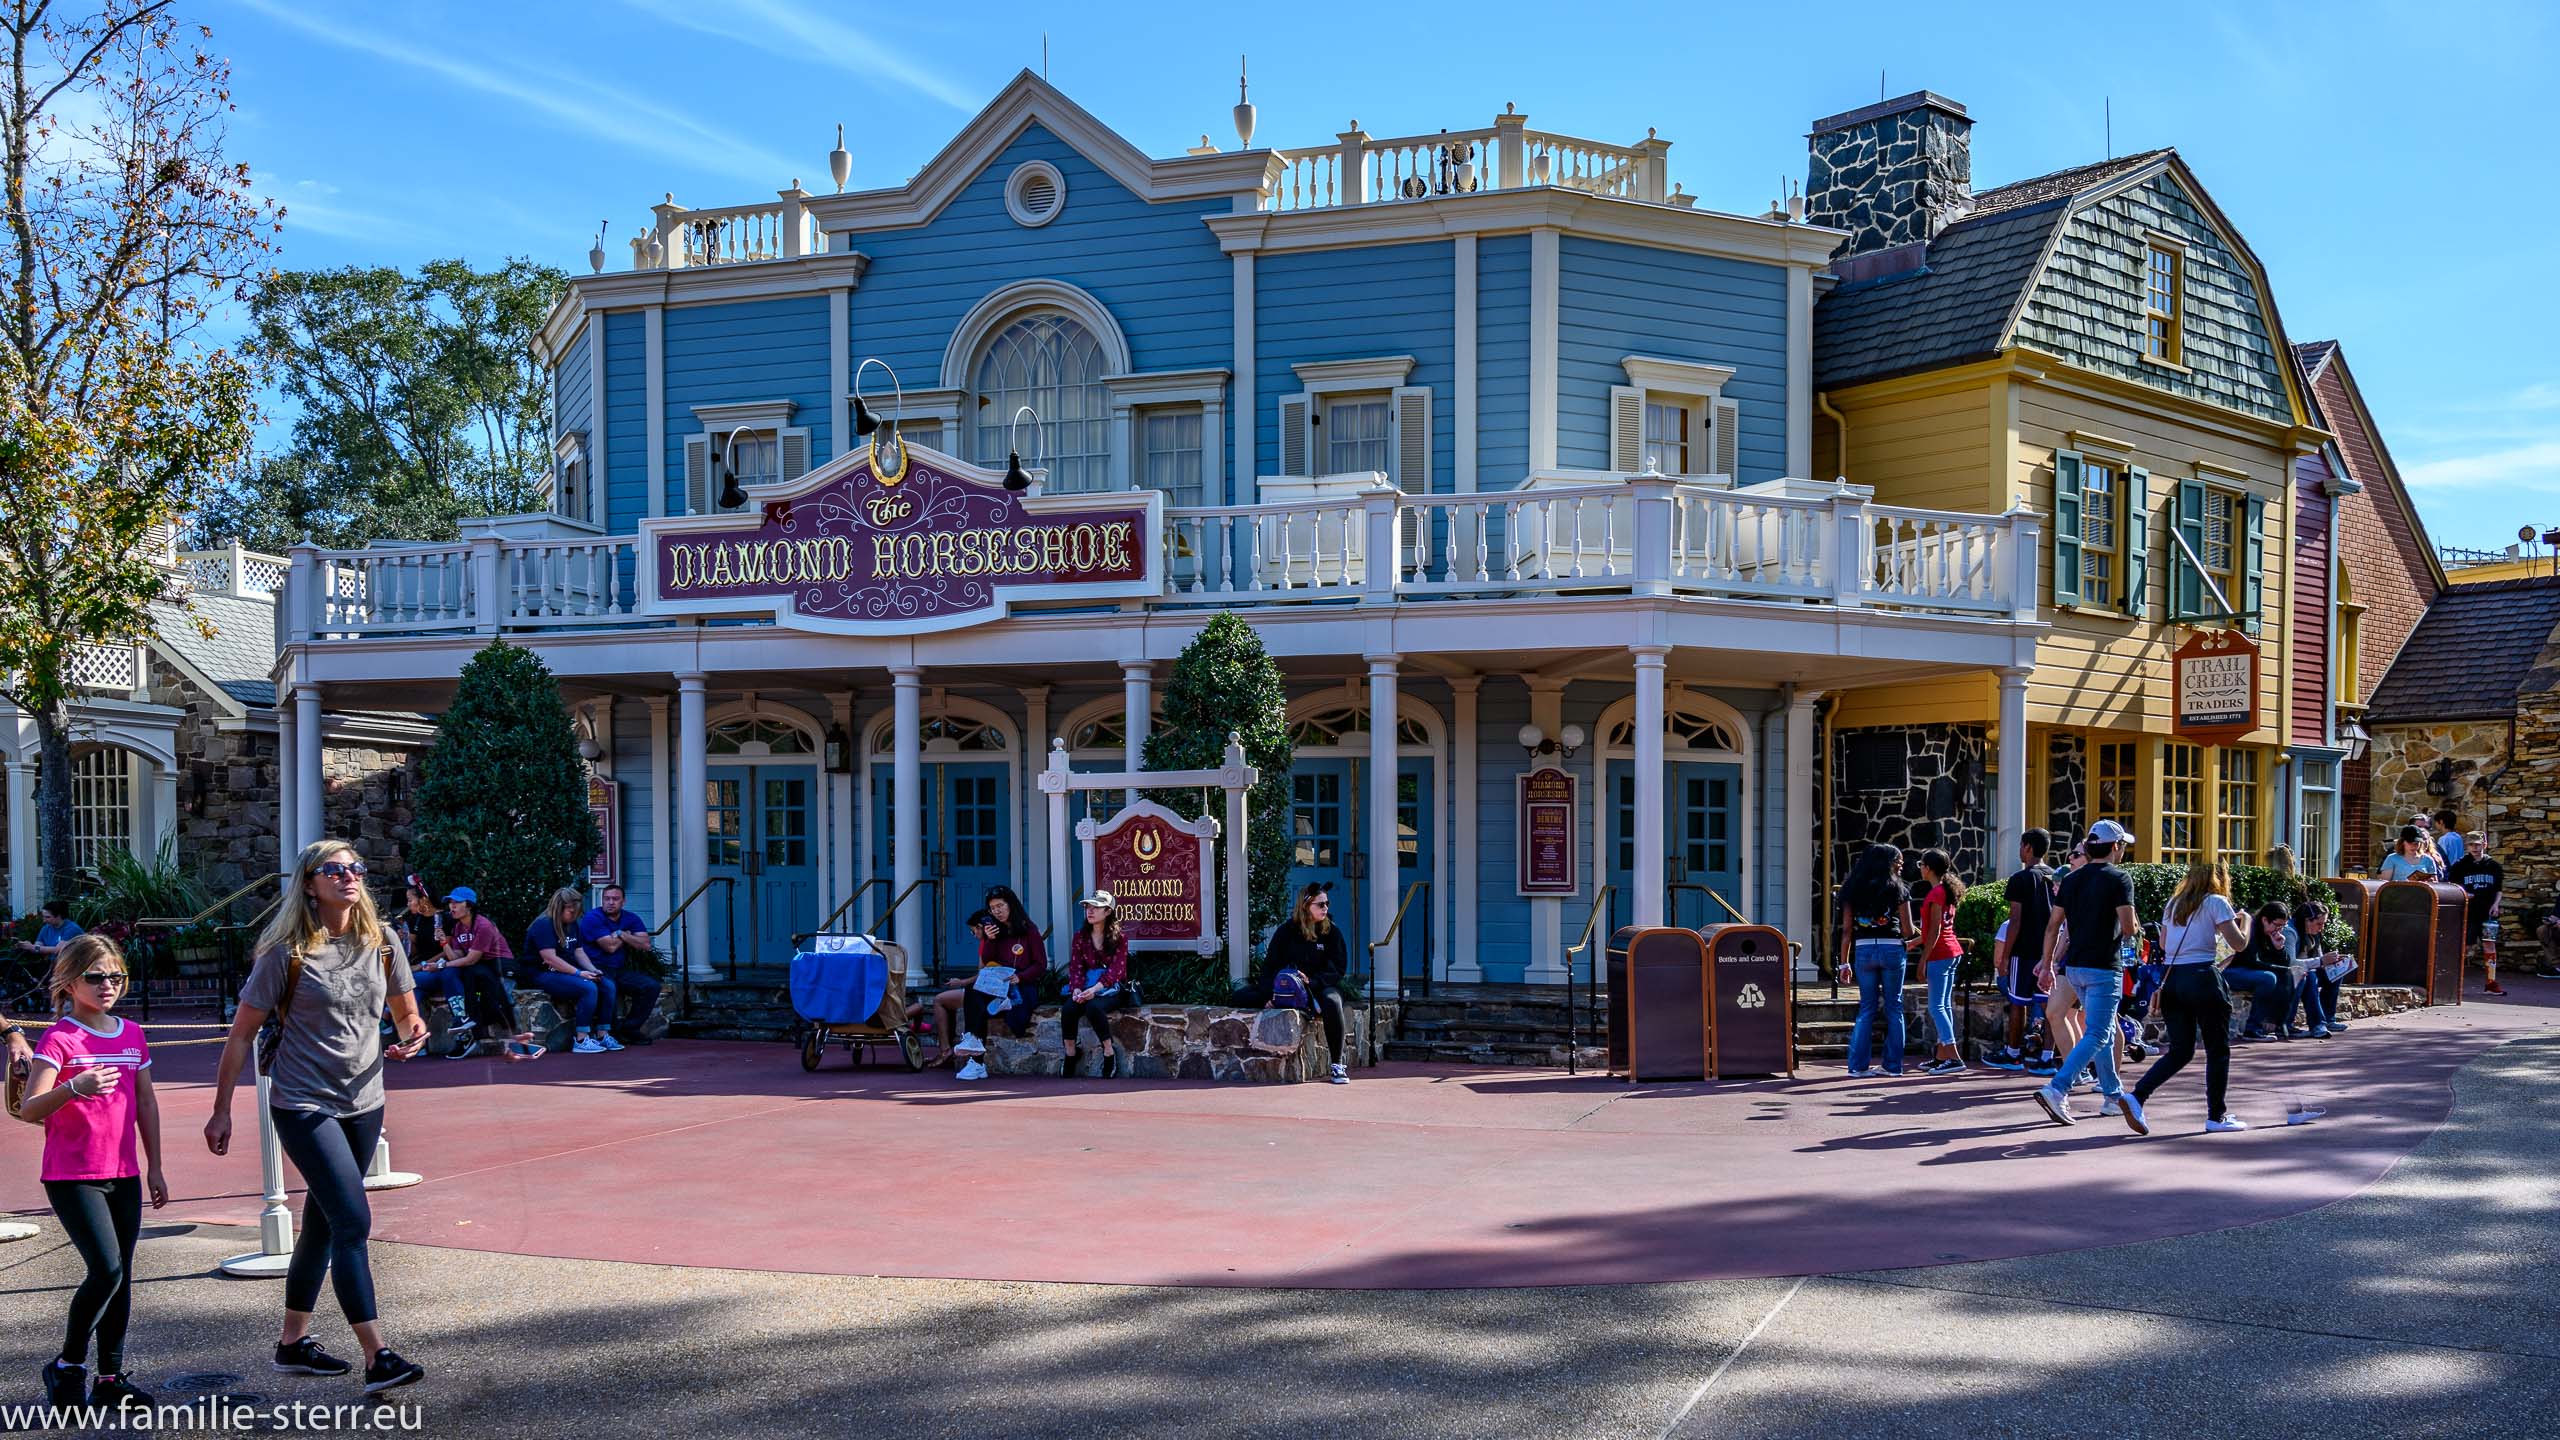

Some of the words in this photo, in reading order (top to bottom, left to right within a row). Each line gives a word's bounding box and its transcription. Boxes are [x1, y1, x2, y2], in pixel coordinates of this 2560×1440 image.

[866, 494, 913, 526] The
[670, 535, 853, 590] DIAMOND
[871, 521, 1132, 579] HORSESHOE
[2187, 657, 2245, 674] TRAIL
[2184, 671, 2248, 689] CREEK
[2187, 698, 2244, 710] TRADERS
[1532, 780, 1566, 789] DIAMOND
[1140, 862, 1156, 874] The
[1113, 879, 1183, 897] DIAMOND
[1115, 903, 1195, 922] ORSESHOE
[1766, 954, 1779, 963] Only
